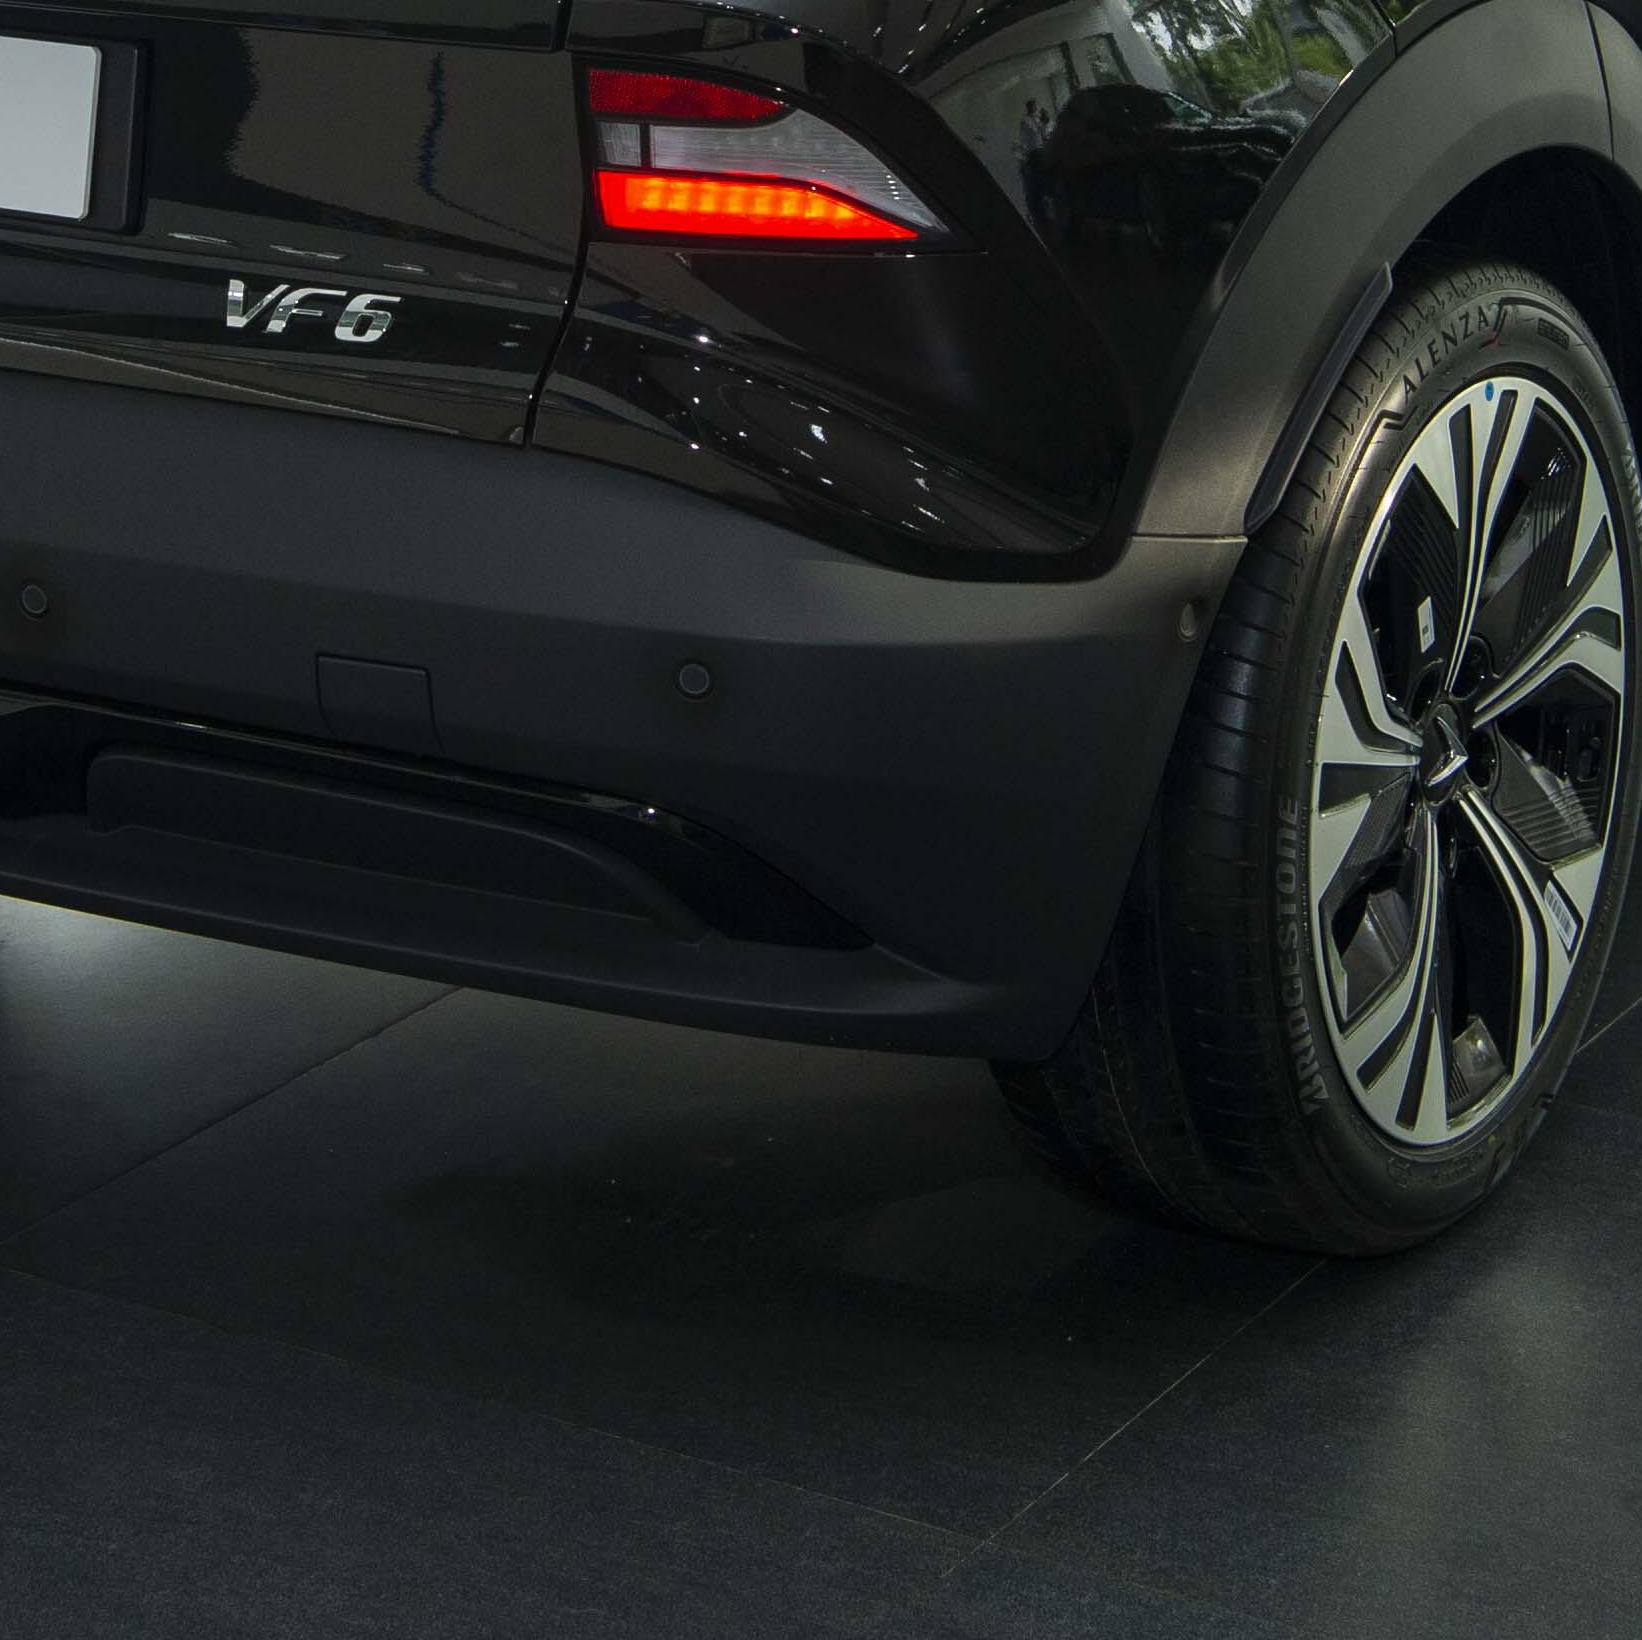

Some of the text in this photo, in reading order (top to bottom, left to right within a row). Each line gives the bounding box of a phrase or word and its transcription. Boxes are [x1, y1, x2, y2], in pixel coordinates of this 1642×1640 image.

[226, 279, 402, 343] VF6
[1402, 304, 1489, 405] ALENZA
[1276, 796, 1330, 1110] BRIDGESTONE
